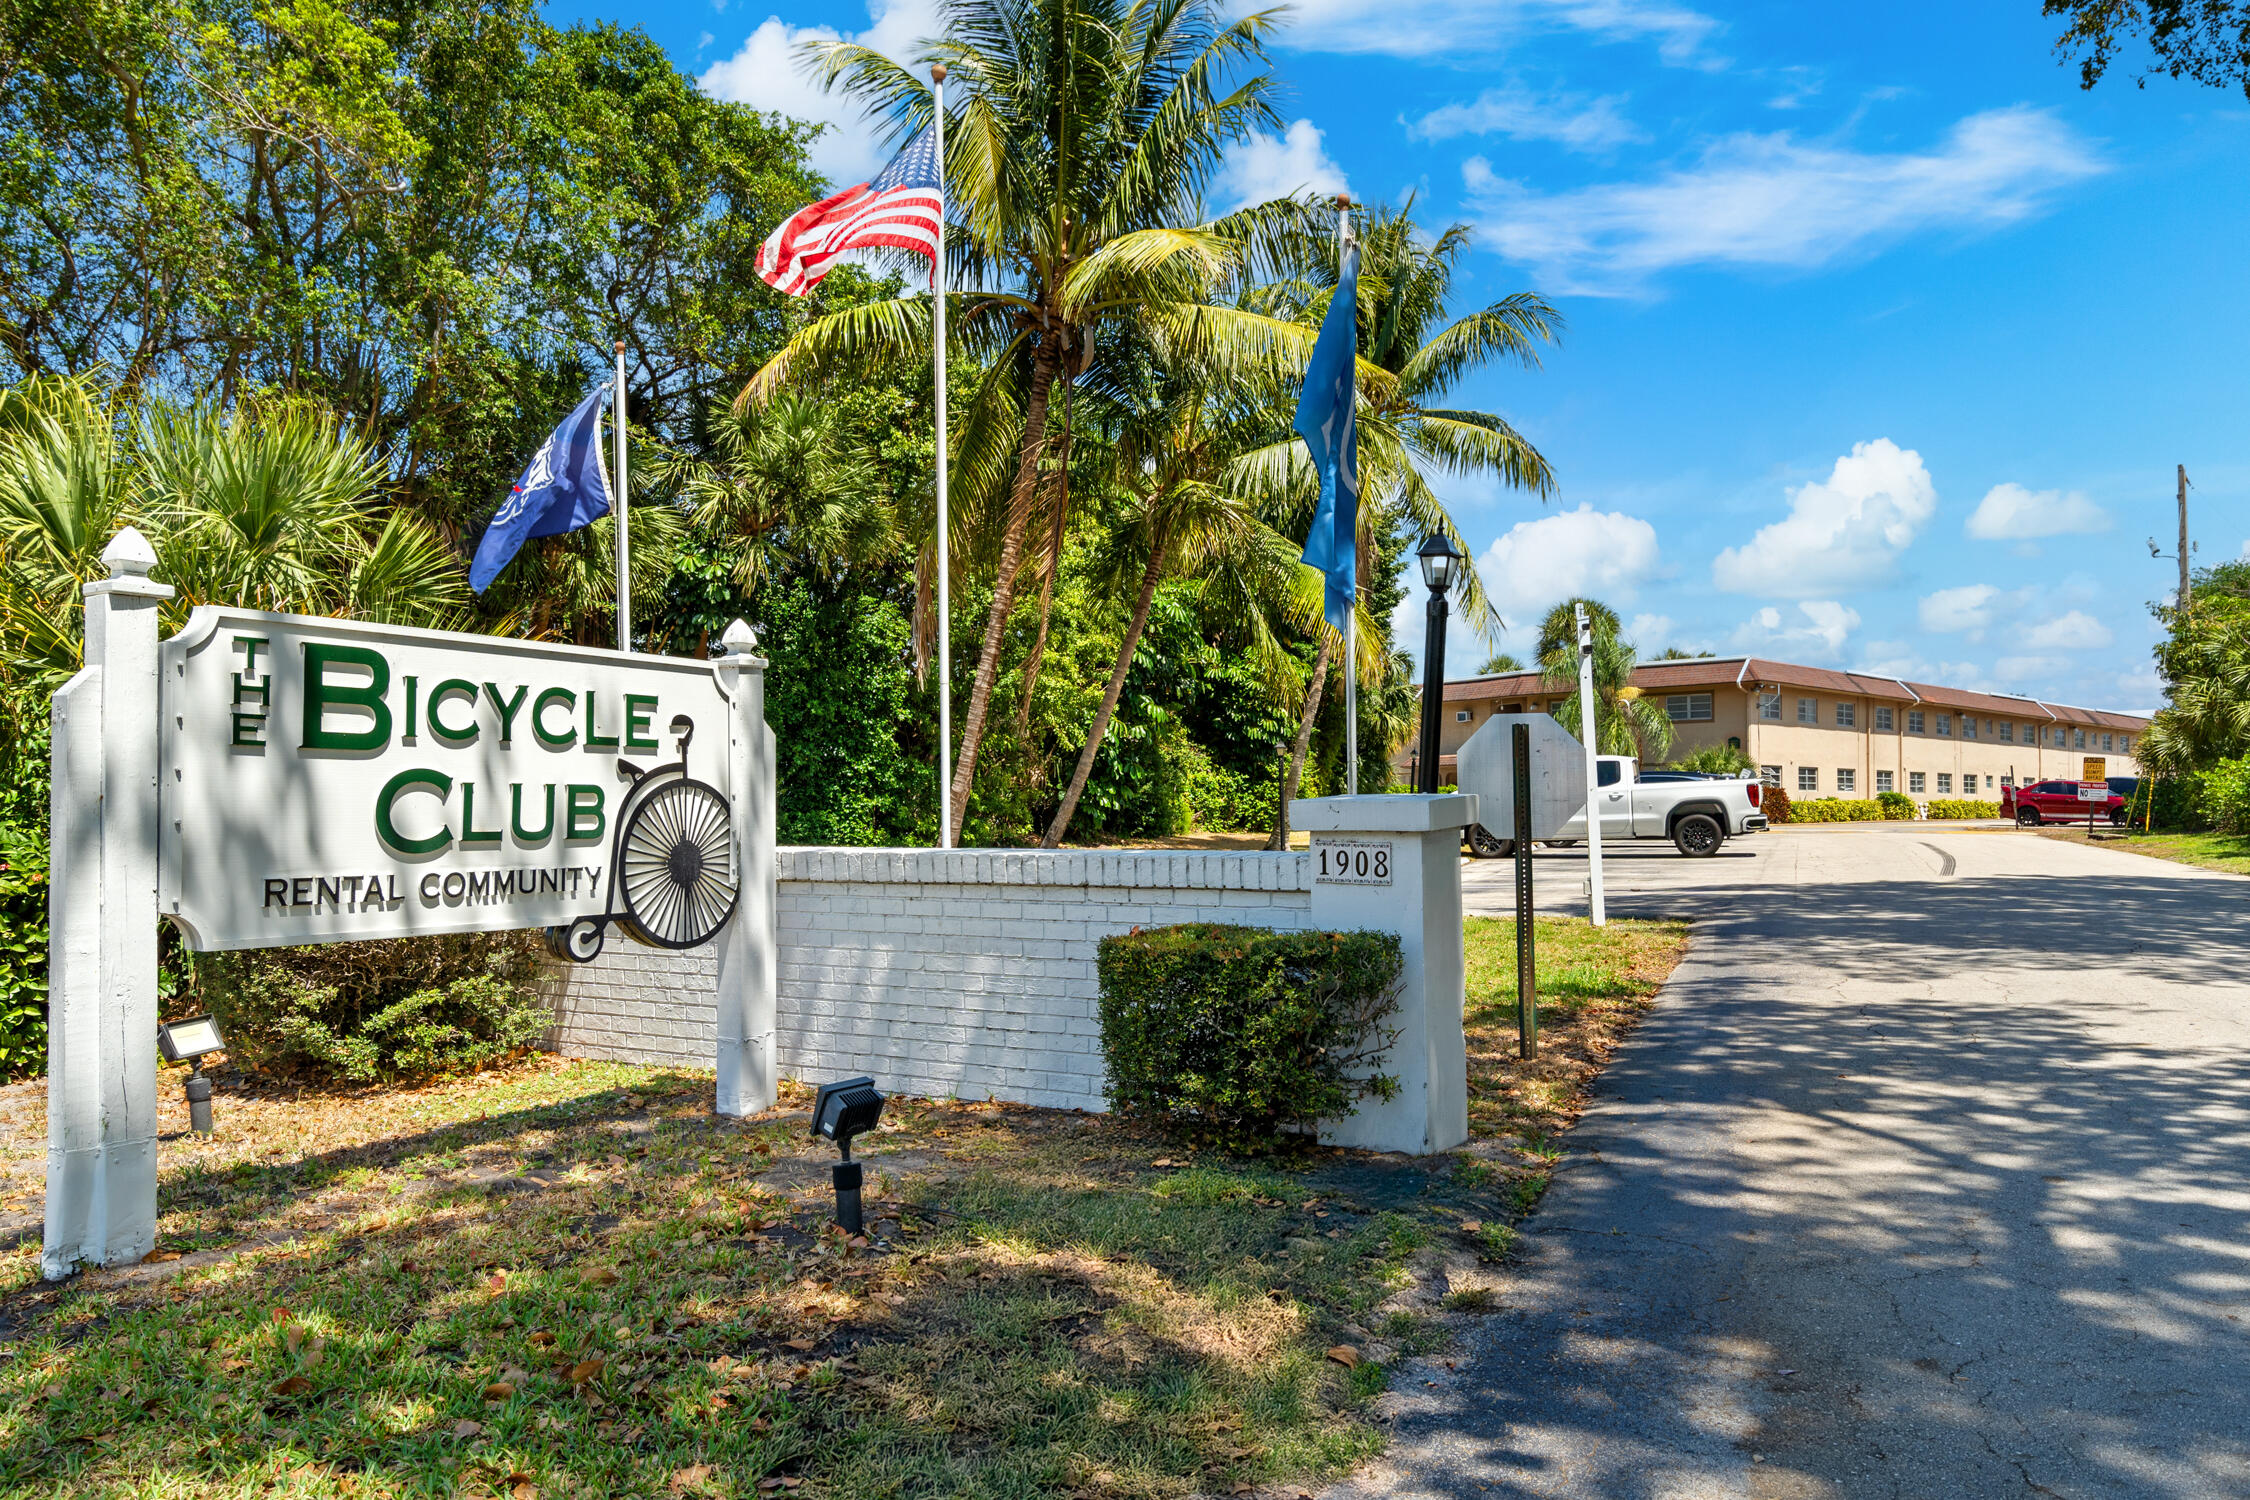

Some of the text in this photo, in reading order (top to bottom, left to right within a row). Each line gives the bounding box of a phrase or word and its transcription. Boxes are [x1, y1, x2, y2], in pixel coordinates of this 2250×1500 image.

[230, 636, 271, 747] THE
[299, 641, 659, 751] BICYCLE
[375, 768, 606, 854] CLUB
[2080, 789, 2089, 798] NO
[264, 866, 602, 908] RENTAL COMMUNITY
[1319, 848, 1389, 878] 1908
